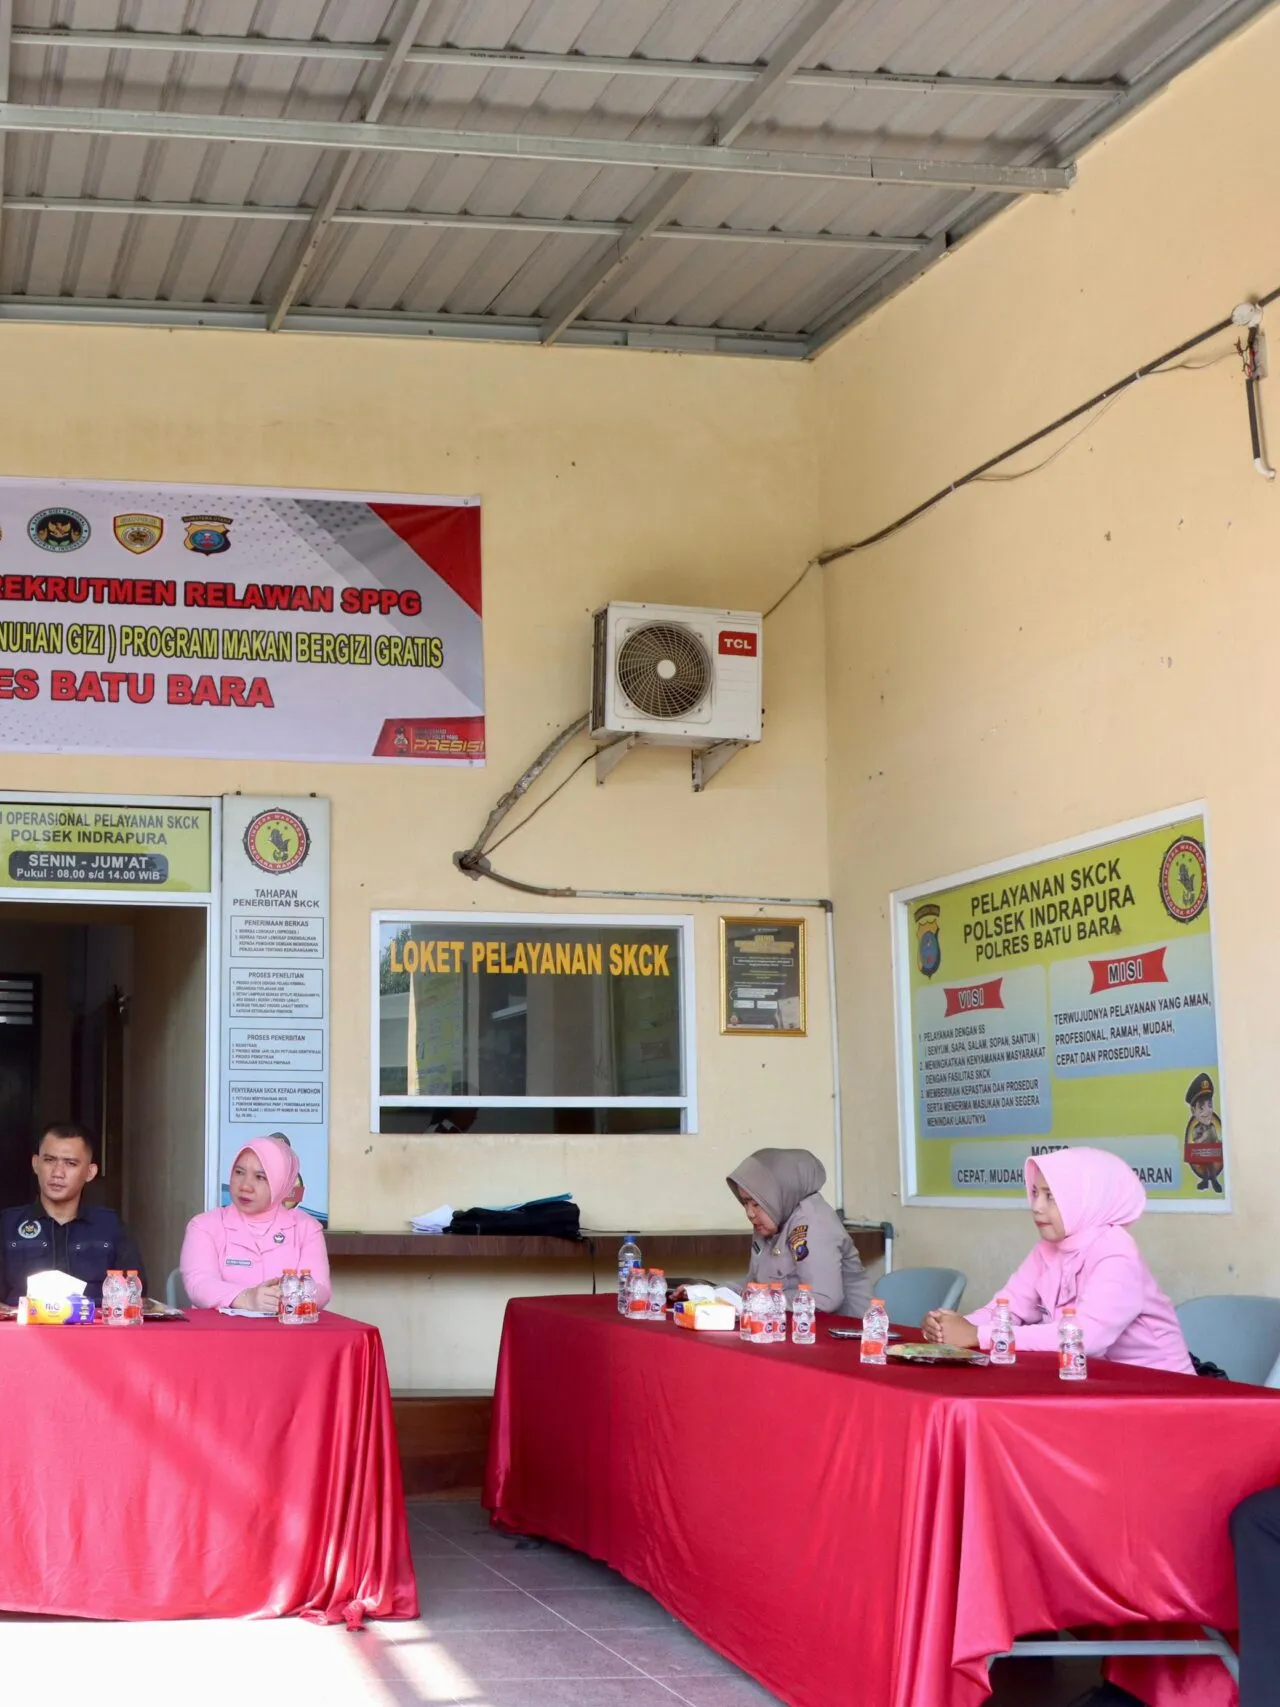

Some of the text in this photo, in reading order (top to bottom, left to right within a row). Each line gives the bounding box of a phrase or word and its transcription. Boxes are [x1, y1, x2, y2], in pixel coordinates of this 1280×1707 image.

[184, 581, 334, 612] RELAWAN
[340, 587, 422, 617] SPPG
[67, 623, 106, 655] GIZI
[120, 626, 218, 660] PROGRAM
[222, 628, 293, 663] MAKAN
[295, 631, 372, 665] BERGIZI
[375, 634, 444, 669] GRATIS
[723, 638, 752, 649] TCL
[50, 669, 156, 705] BATU
[166, 673, 275, 709] BARA
[413, 739, 485, 753] PRESISI
[6, 811, 91, 828] OPERASIONAL
[94, 814, 164, 829] PELAYANAN
[166, 815, 200, 830] SKCK
[11, 829, 168, 845] POLSEK INDRAPURA
[28, 854, 77, 867] SENIN
[91, 855, 149, 869] JUM'AT
[16, 868, 47, 878] Pukul
[57, 869, 85, 879] 08.00
[88, 869, 105, 880] s/d
[108, 870, 136, 880] 14.00
[138, 871, 160, 881] WIB
[254, 889, 298, 899] TAHAPAN
[971, 872, 1066, 917] PELAYANAN
[1070, 857, 1122, 892] SKCK
[233, 899, 320, 908] PENERBITAN SKCK
[964, 910, 1026, 944] POLSEK
[1029, 884, 1136, 929] INDRAPURA
[976, 914, 1123, 962] POLRES BATU BARA
[389, 940, 670, 977] LOKET PELAYANAN SKCK
[1107, 959, 1144, 984] MISI
[958, 987, 985, 1009] VISI
[1053, 992, 1212, 1026] TERWUJUDNYA PELAYANAN YANG AMAN,
[924, 1029, 954, 1042] PELAYANAN
[955, 1026, 978, 1038] DENGAN
[1055, 1019, 1175, 1046] PROFESIONAL, RAMAH, MUDAH,
[924, 1046, 1046, 1070] MENINGKATKAN KENYAMANAN MASYARAKAT
[1056, 1045, 1151, 1066] CEPAT DAN PROSEDURAL
[926, 1068, 991, 1085] DENGAN FASILITAS SKCK
[925, 1079, 1039, 1099] MEMBERIKAN KEPASTIAN DAN PROSEDUR
[926, 1095, 1040, 1113] SERTA MENERIMA MASUKAN DAN SEGERA
[955, 1113, 987, 1126] LANJUTNYA
[957, 1168, 987, 1184] CEPAT,
